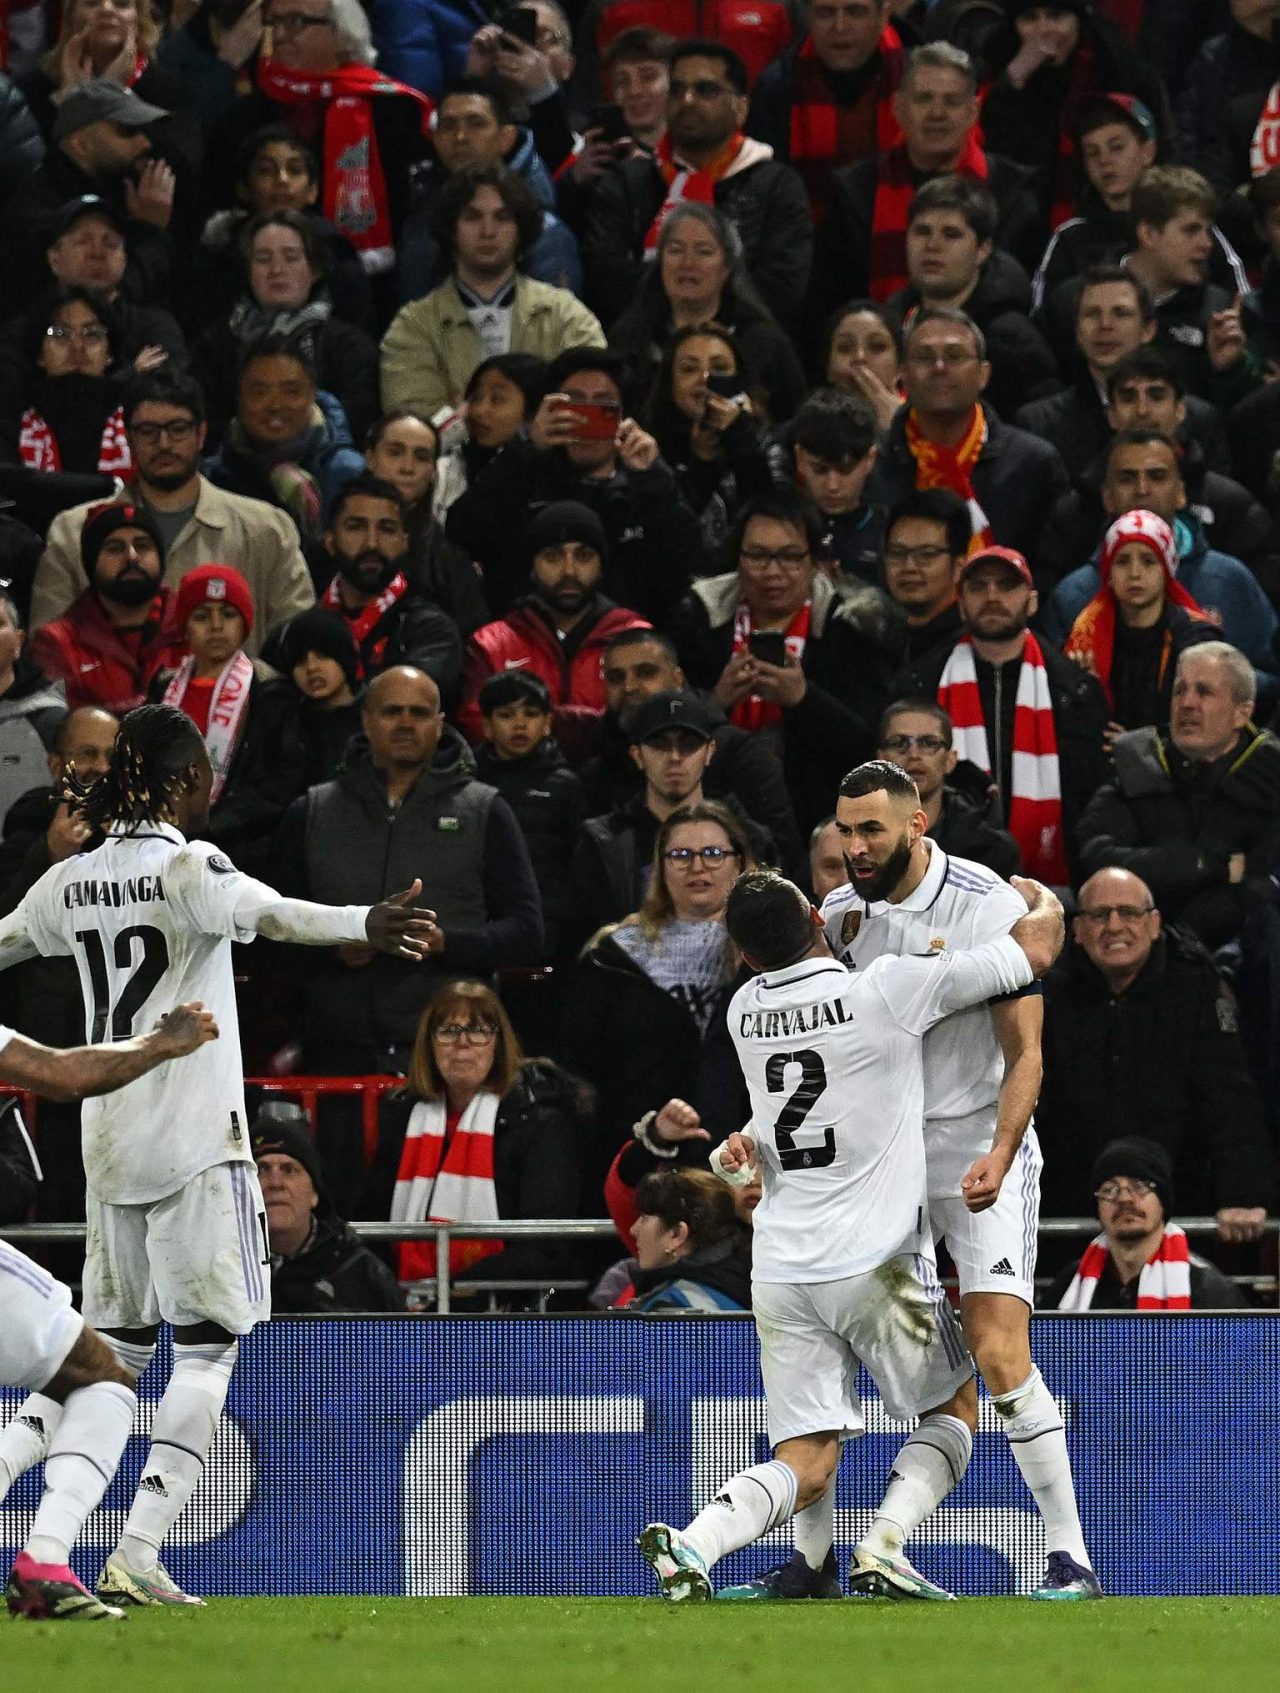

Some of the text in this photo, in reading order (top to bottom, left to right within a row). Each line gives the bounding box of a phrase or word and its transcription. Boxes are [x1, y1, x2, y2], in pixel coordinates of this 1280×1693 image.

[75, 924, 170, 1046] 12
[739, 997, 854, 1039] CARVAJAL
[765, 1049, 837, 1172] 2
[989, 1268, 1016, 1277] adidas
